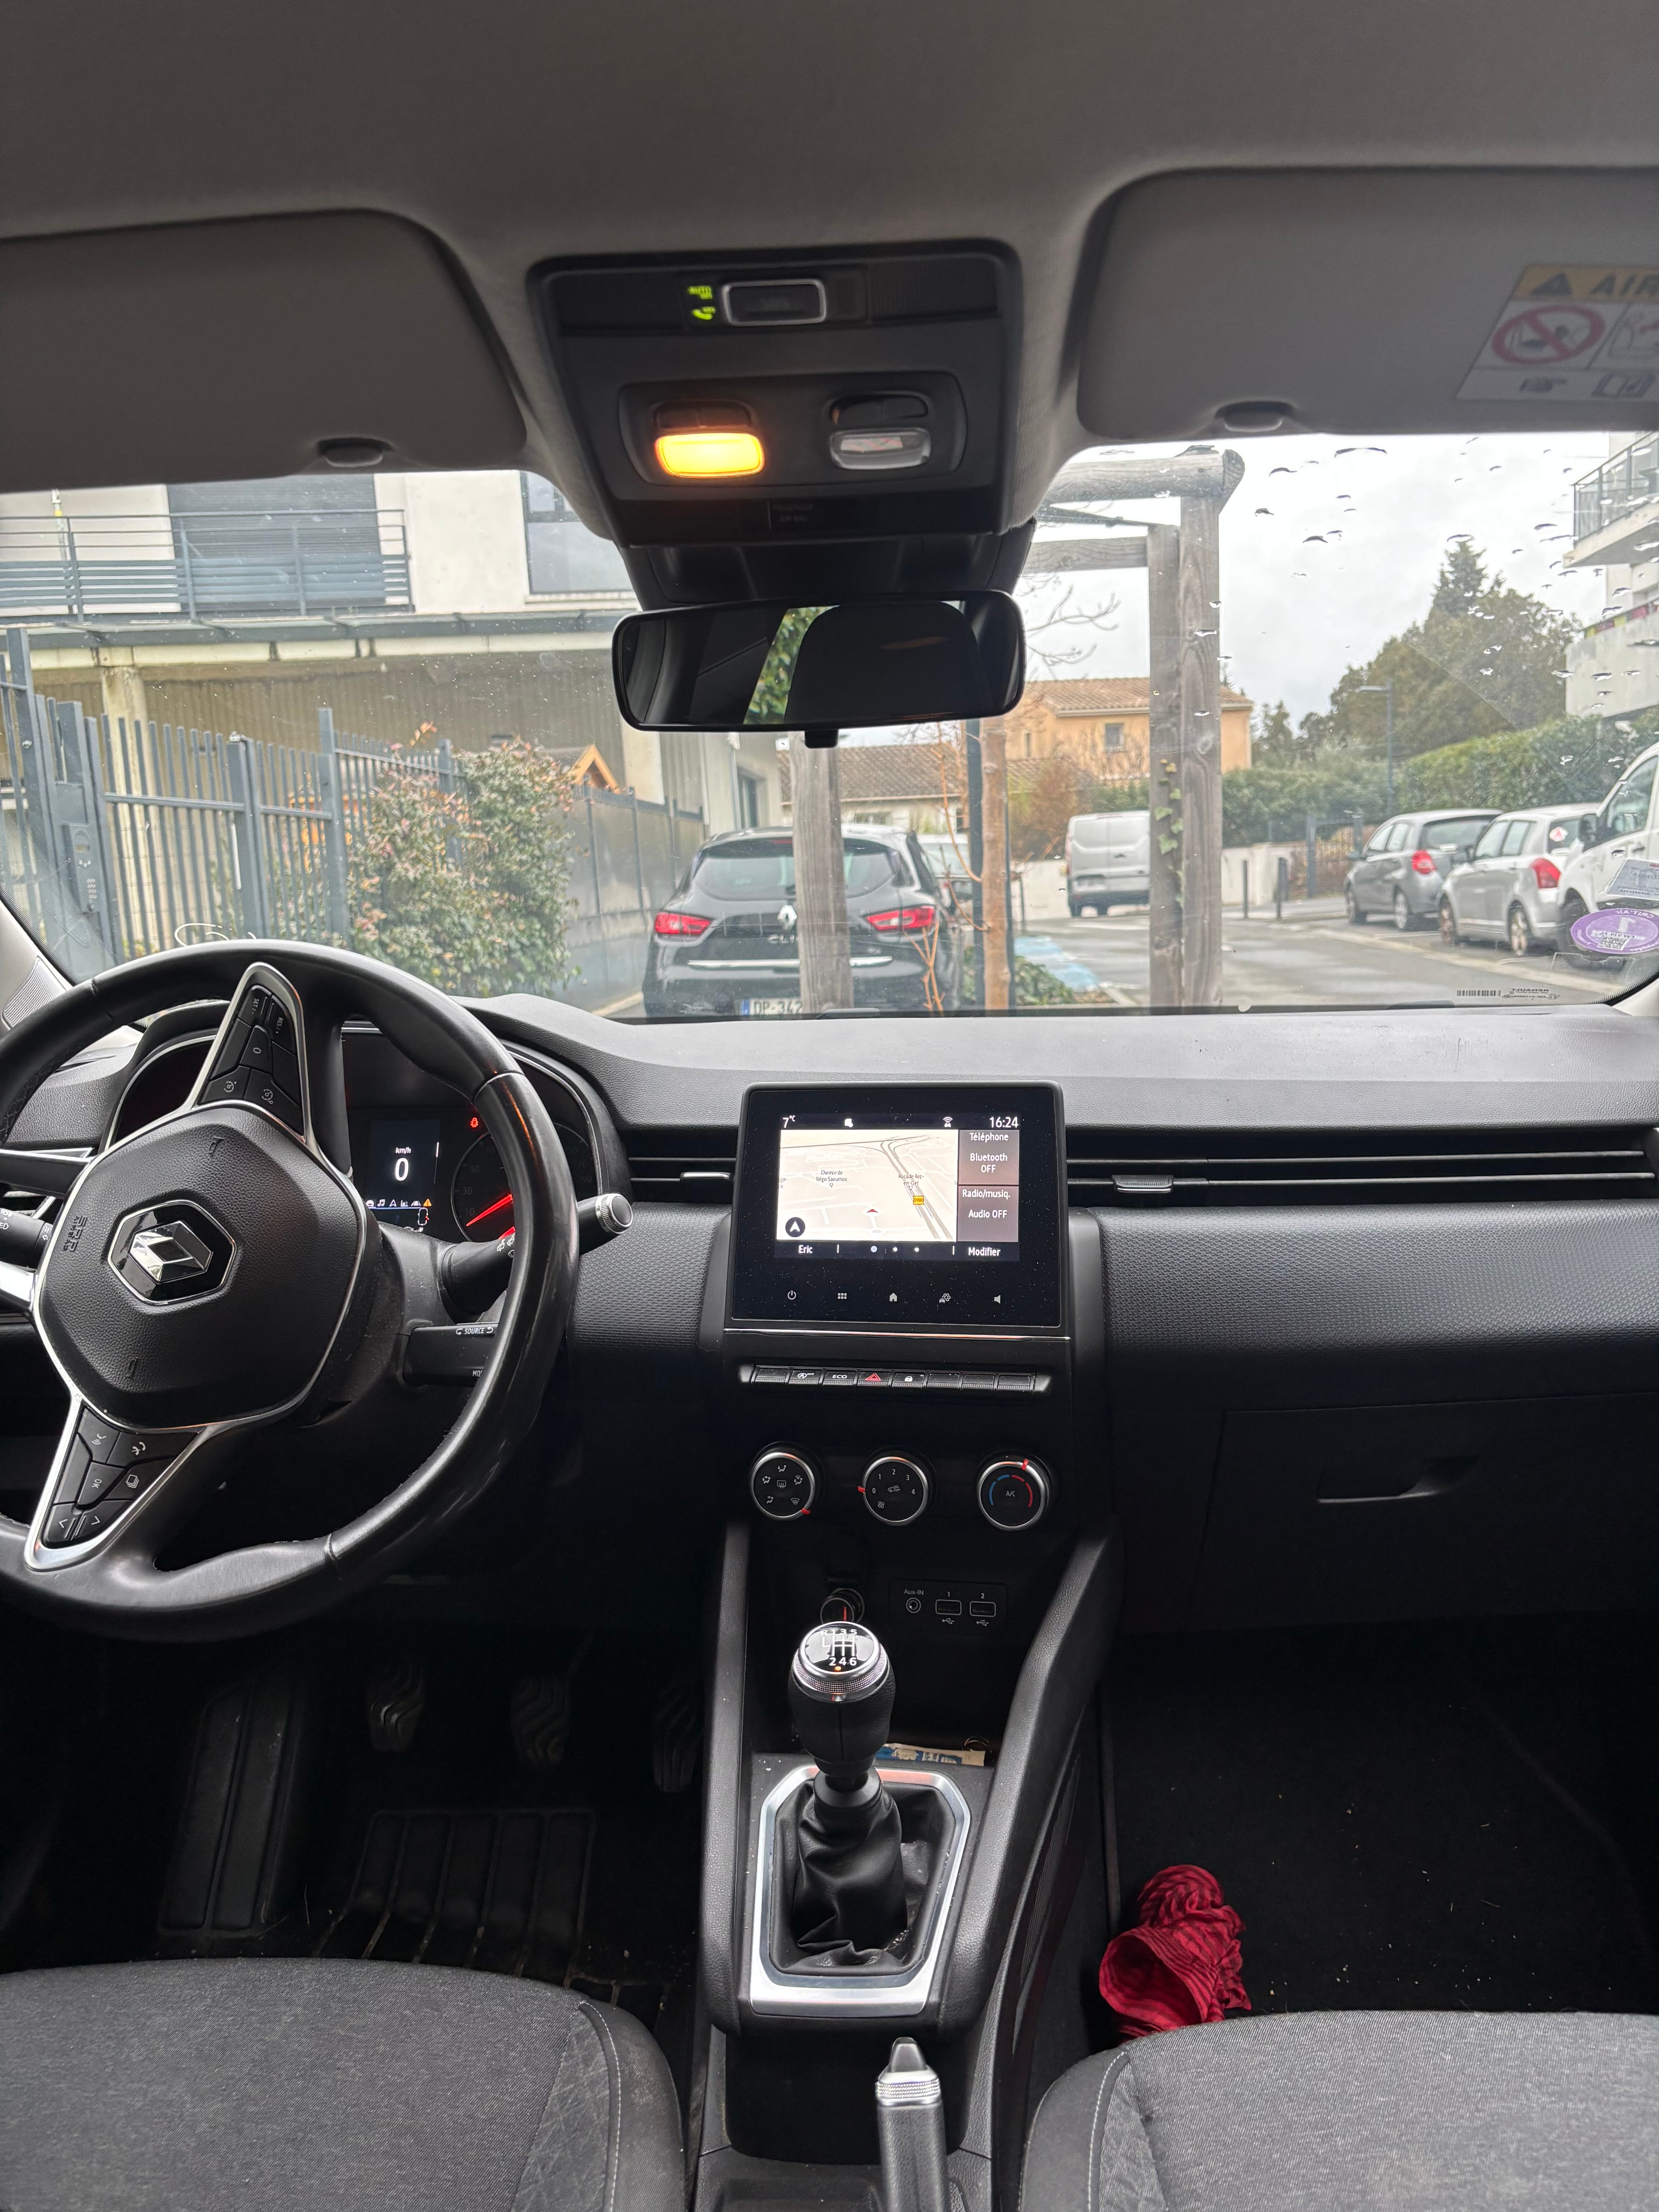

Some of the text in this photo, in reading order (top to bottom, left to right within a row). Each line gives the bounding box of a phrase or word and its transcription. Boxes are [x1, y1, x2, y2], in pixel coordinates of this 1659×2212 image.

[989, 1116, 1019, 1128] 16:24
[969, 1132, 1009, 1143] Téléphone
[970, 1153, 1008, 1162] Bluetooth
[395, 1157, 409, 1181] 0
[470, 1165, 480, 1174] 50
[981, 1164, 996, 1173] OFF
[462, 1187, 472, 1195] 30
[962, 1189, 1011, 1200] Radio/musiq.
[465, 1208, 475, 1216] 10
[968, 1209, 1007, 1219] Audio OFF
[798, 1245, 813, 1254] Eric
[968, 1247, 1001, 1257] Modifier
[91, 1479, 102, 1489] OK
[829, 1657, 857, 1666] 2 4 6
